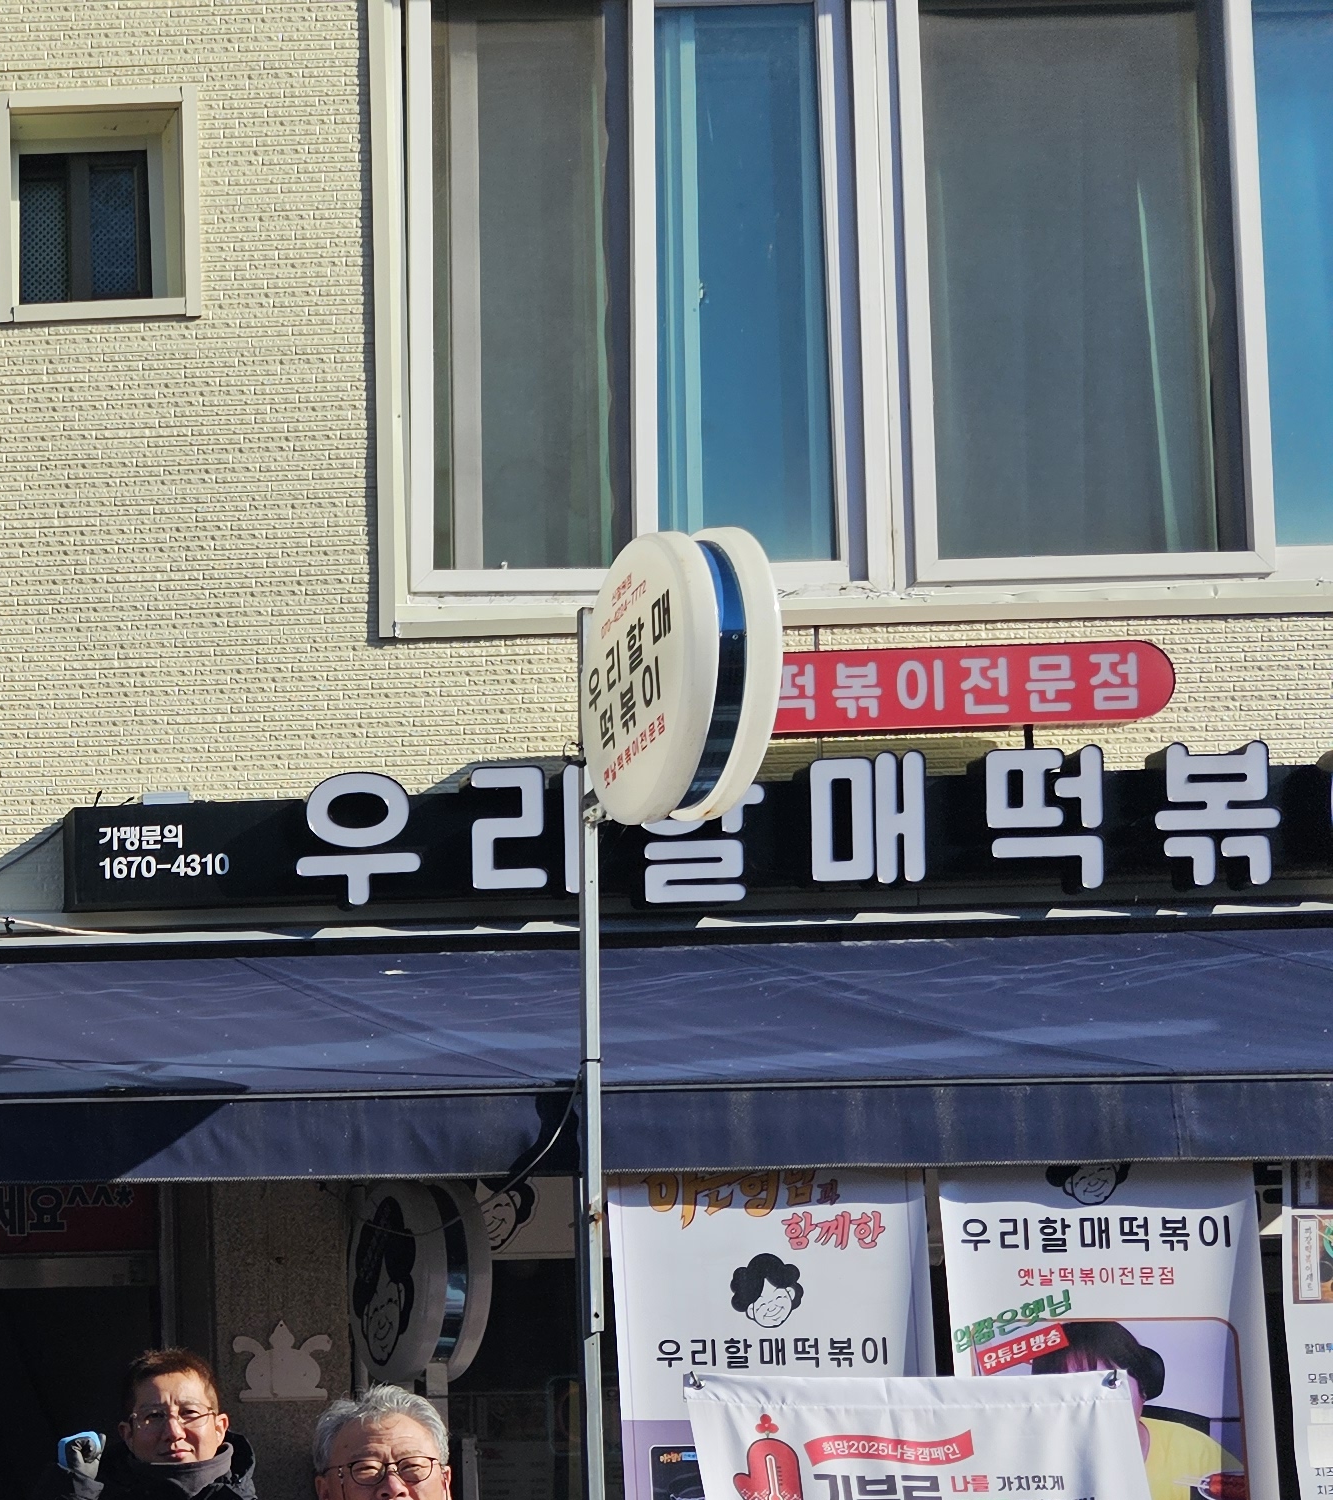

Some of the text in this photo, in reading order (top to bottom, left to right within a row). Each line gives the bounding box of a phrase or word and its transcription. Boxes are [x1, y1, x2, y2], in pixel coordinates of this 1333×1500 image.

[588, 588, 672, 713] 우리할매
[599, 655, 661, 751] 떡볶이
[98, 824, 185, 850] 가맹문의
[98, 853, 230, 880] 1670-4310
[781, 1210, 886, 1250] 함께한
[960, 1215, 1232, 1253] 우리할매떡볶이
[1017, 1266, 1176, 1287] 옛날떡볶이전문점
[953, 1288, 1072, 1353] 입짧은햇님
[656, 1336, 889, 1369] 우리할매떡볶이
[982, 1329, 1063, 1369] 유튜브 방송
[821, 1439, 962, 1462] 희망2025나눔캠페인
[950, 1473, 1065, 1493] 나를 가치있게
